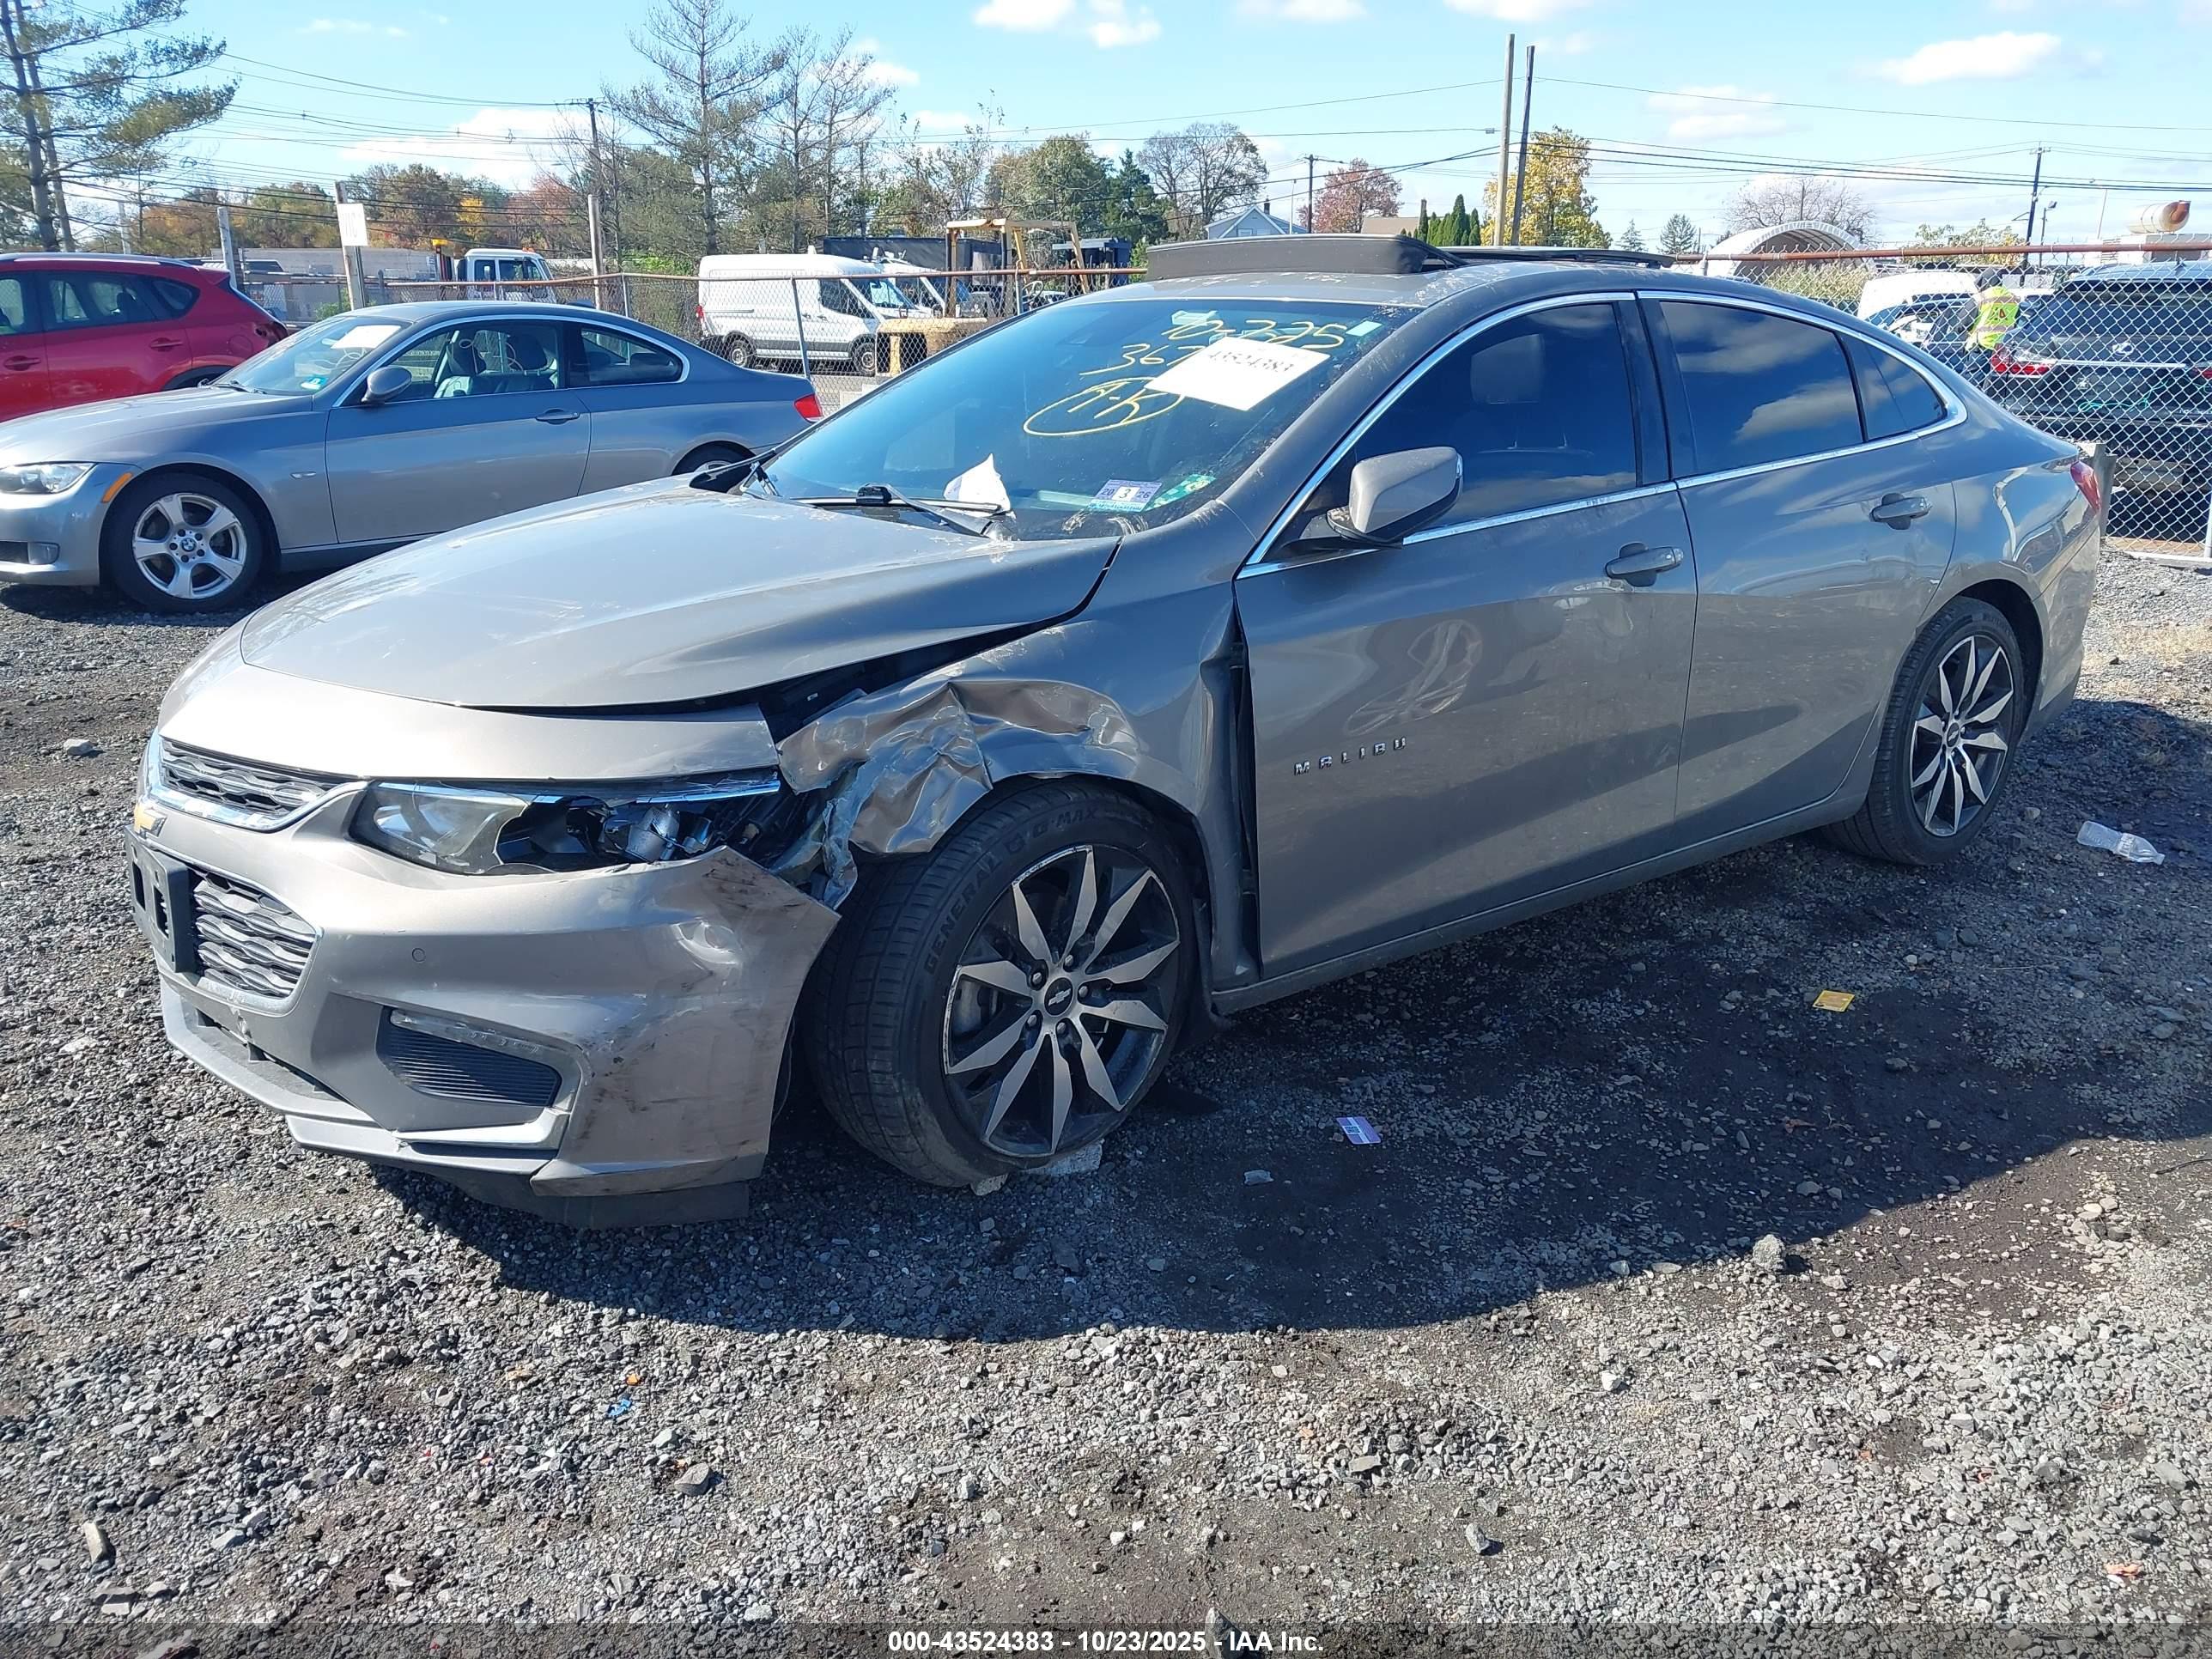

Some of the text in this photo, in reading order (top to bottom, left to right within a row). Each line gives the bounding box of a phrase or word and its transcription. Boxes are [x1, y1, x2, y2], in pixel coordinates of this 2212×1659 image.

[1101, 488, 1151, 500] 20 3 26
[1294, 737, 1407, 776] MALIBU
